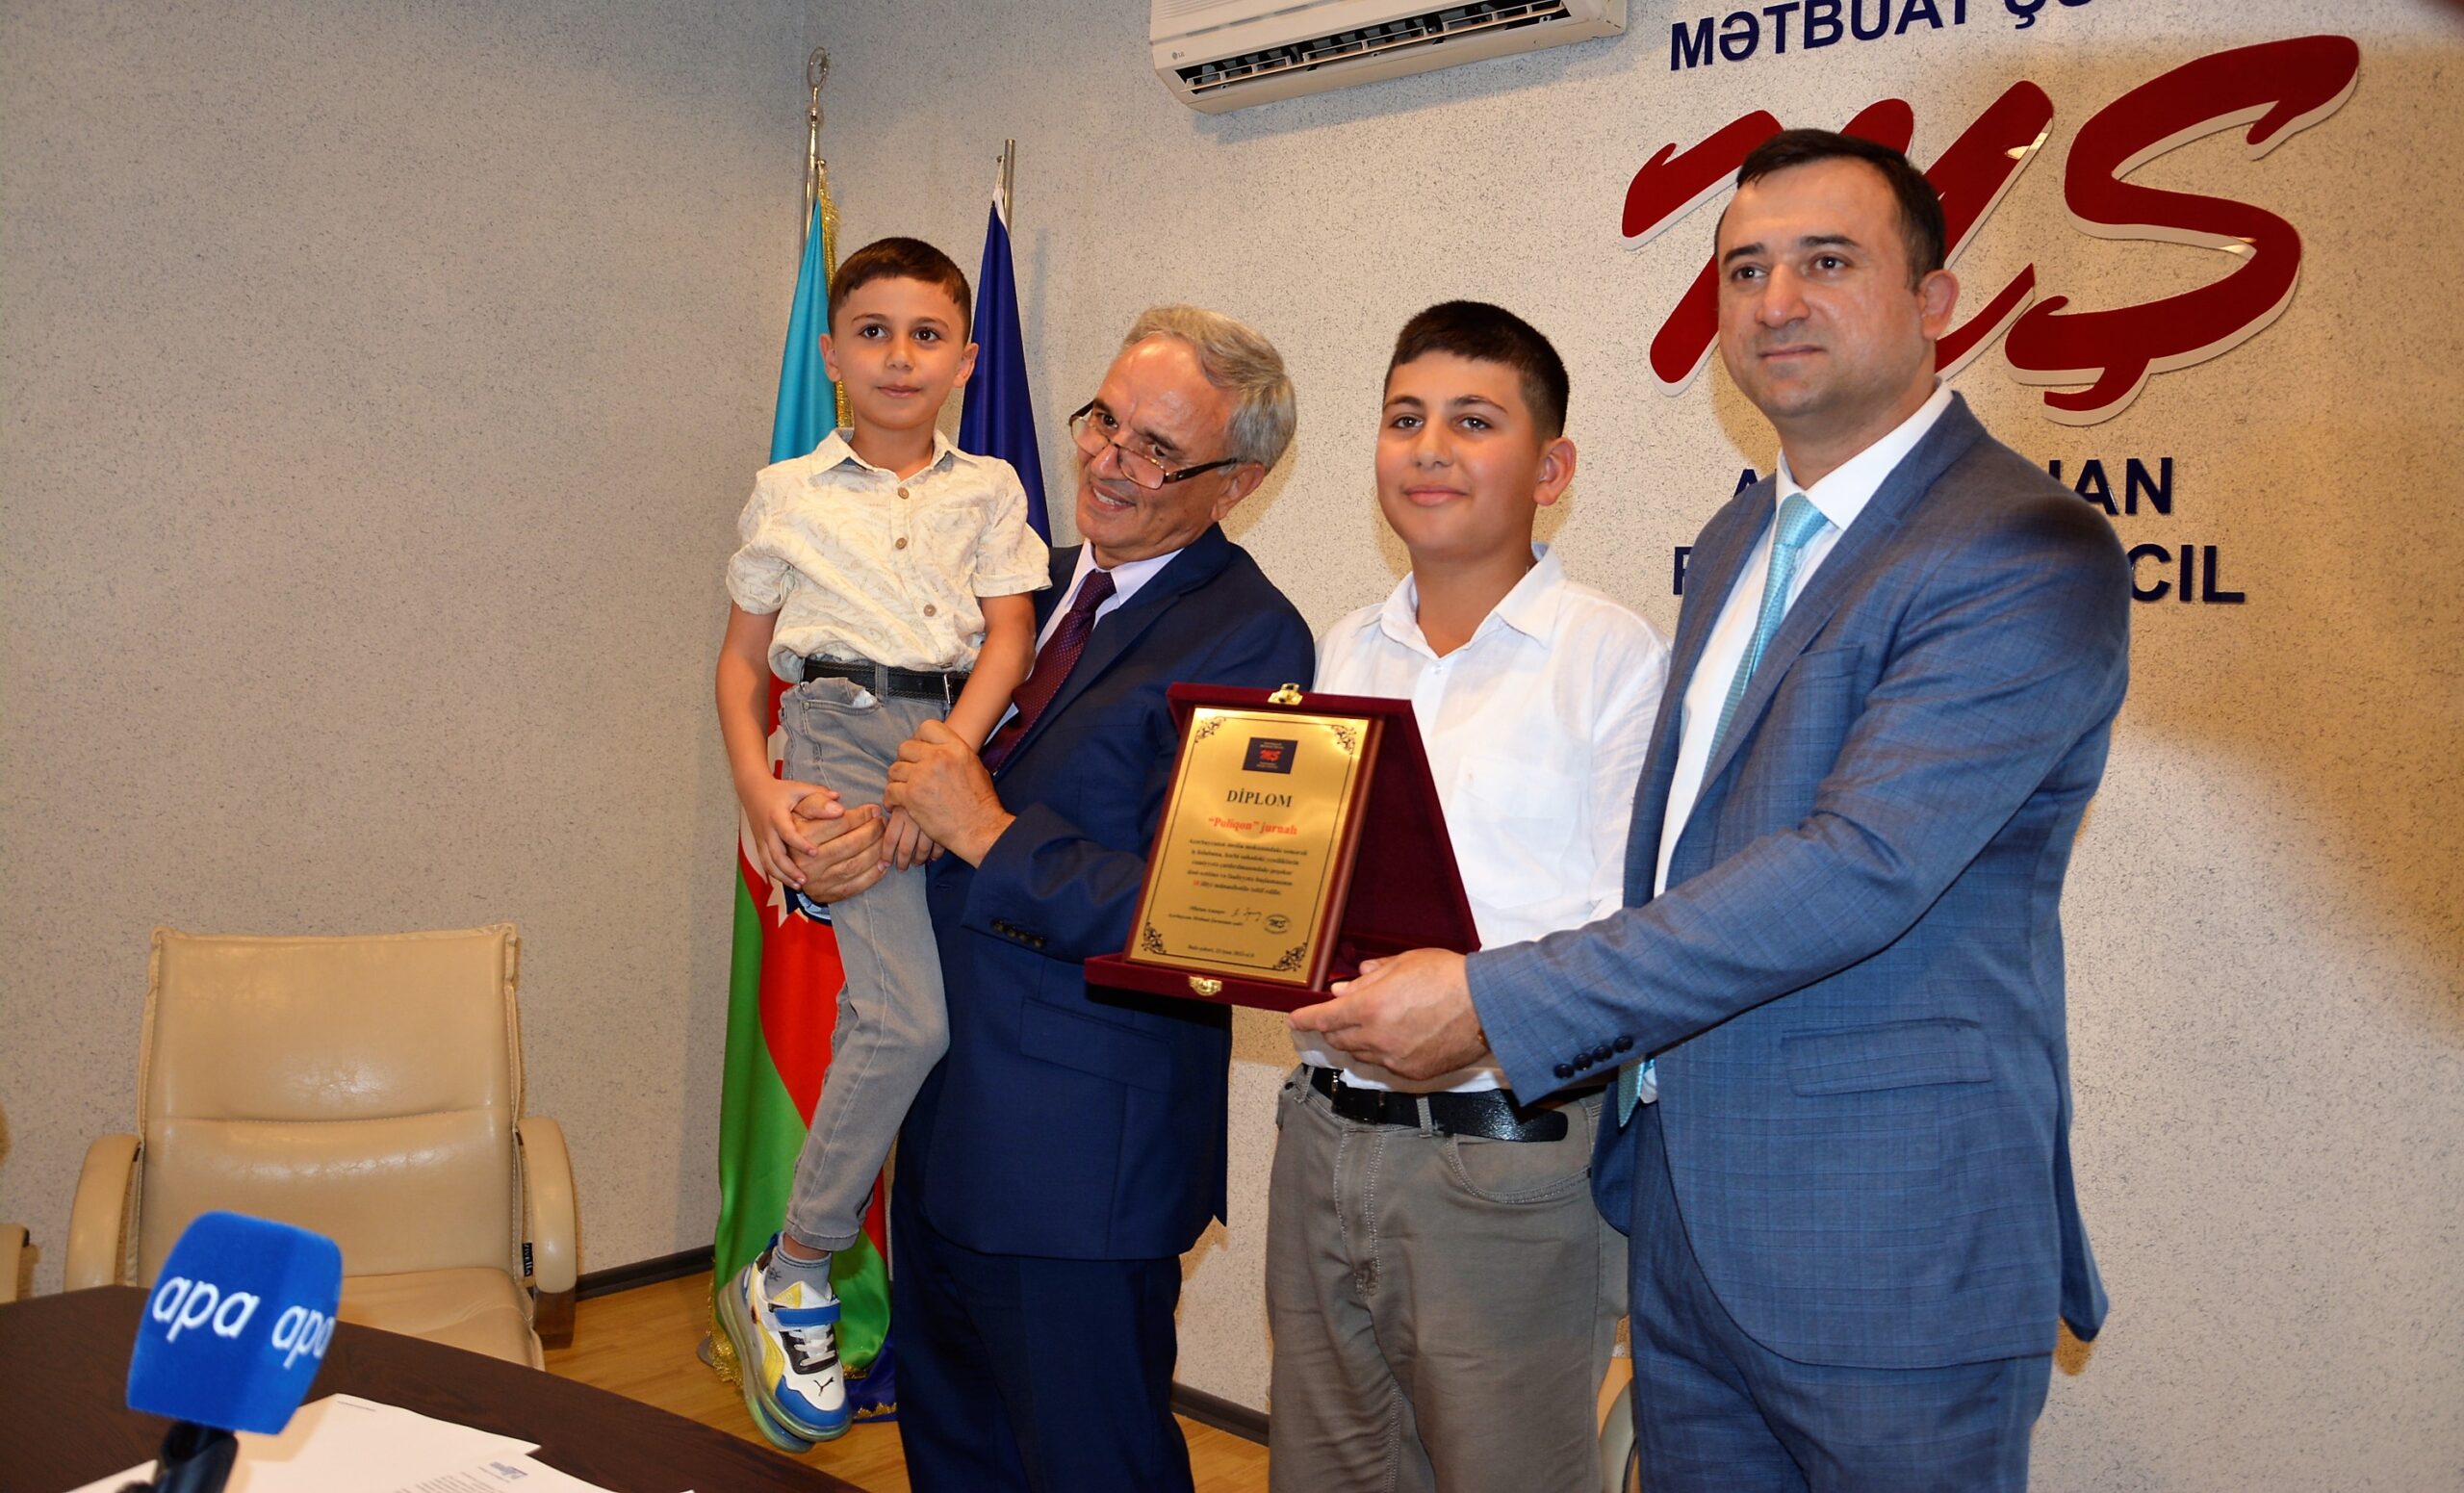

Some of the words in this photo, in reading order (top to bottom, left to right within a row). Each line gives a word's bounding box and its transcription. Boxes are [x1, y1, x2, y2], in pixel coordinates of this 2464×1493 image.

[1226, 787, 1293, 808] DİPLOM
[152, 1275, 261, 1343] apa
[271, 1305, 336, 1370] apa
